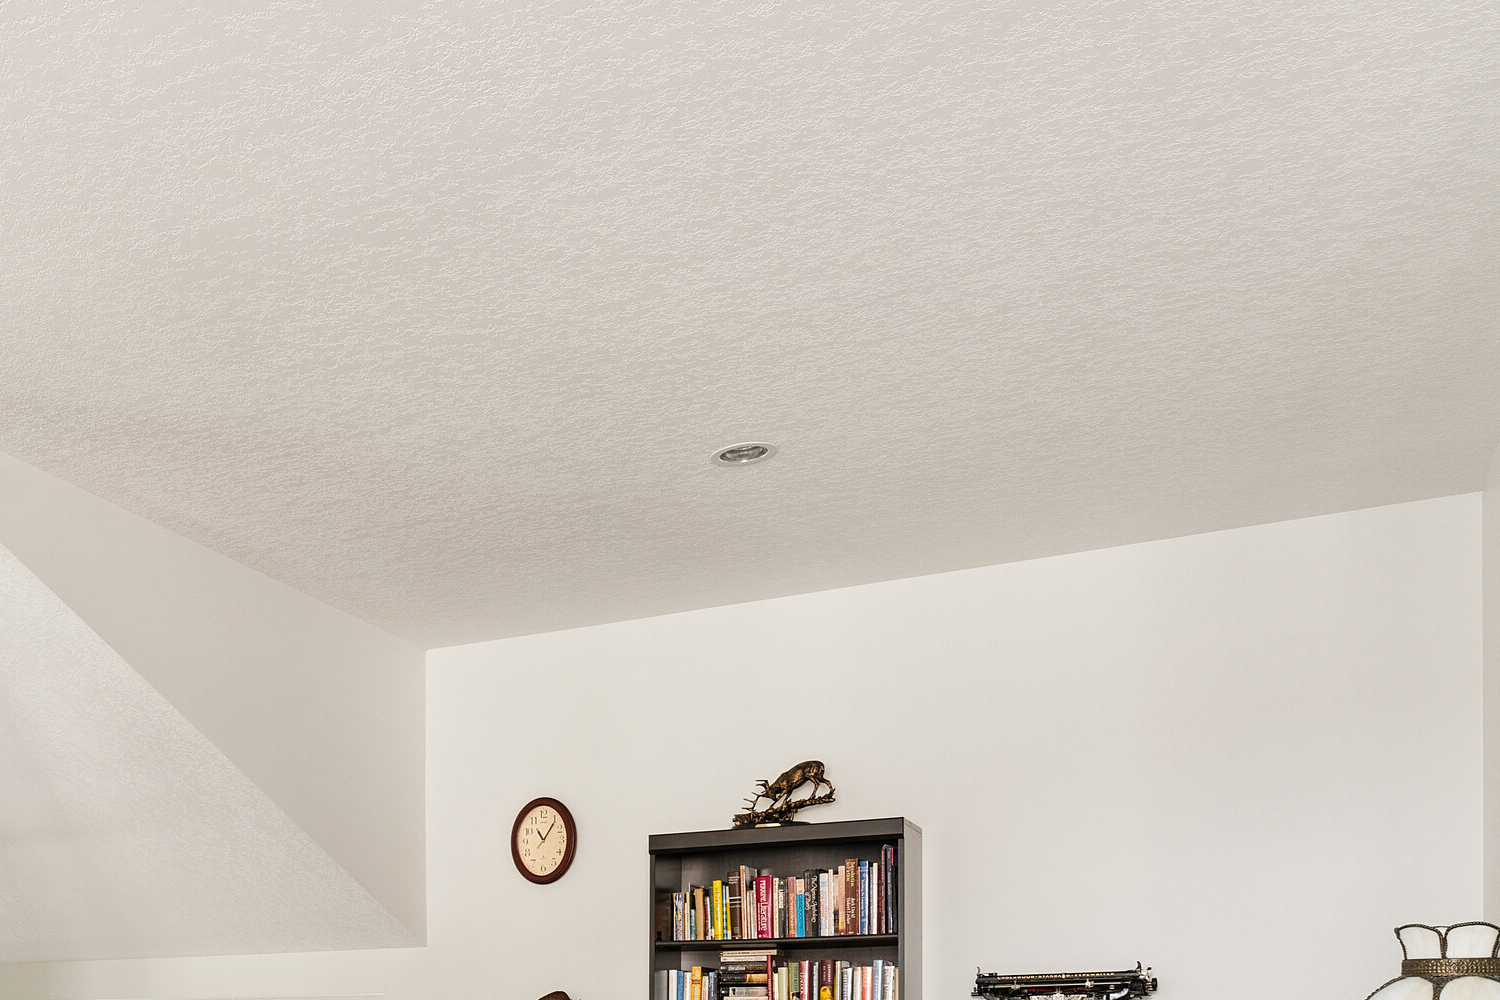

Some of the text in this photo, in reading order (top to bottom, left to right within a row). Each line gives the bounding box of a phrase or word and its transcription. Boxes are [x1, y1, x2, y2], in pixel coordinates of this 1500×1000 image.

[540, 810, 548, 818] 12
[530, 816, 538, 825] 11
[525, 828, 533, 836] 10
[524, 849, 531, 857] 8
[759, 902, 769, 932] Literature
